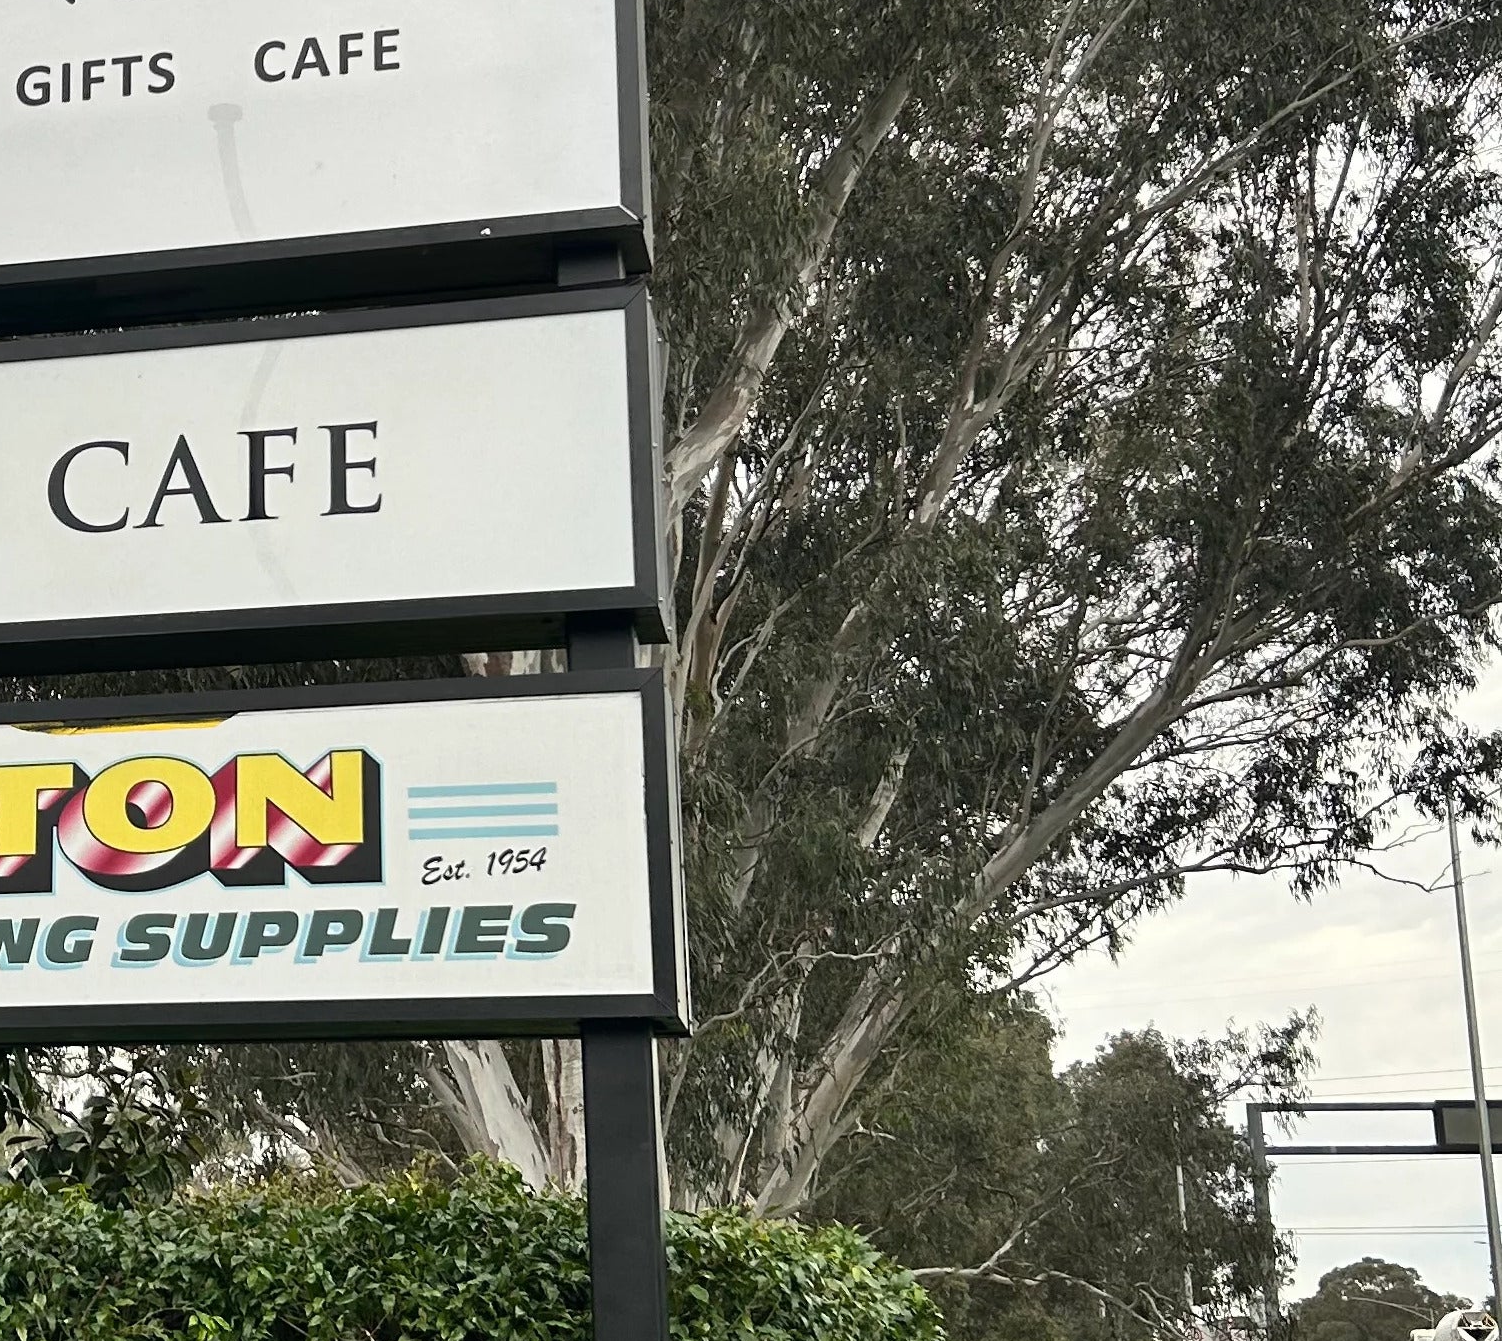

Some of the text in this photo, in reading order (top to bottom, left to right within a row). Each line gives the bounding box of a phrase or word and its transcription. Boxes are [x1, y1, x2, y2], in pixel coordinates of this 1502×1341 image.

[16, 52, 175, 107] GIFTS
[254, 28, 400, 83] CAFE
[47, 420, 382, 533] CAFE
[421, 846, 547, 886] Est. 1954
[110, 902, 578, 971] SUPPLIES
